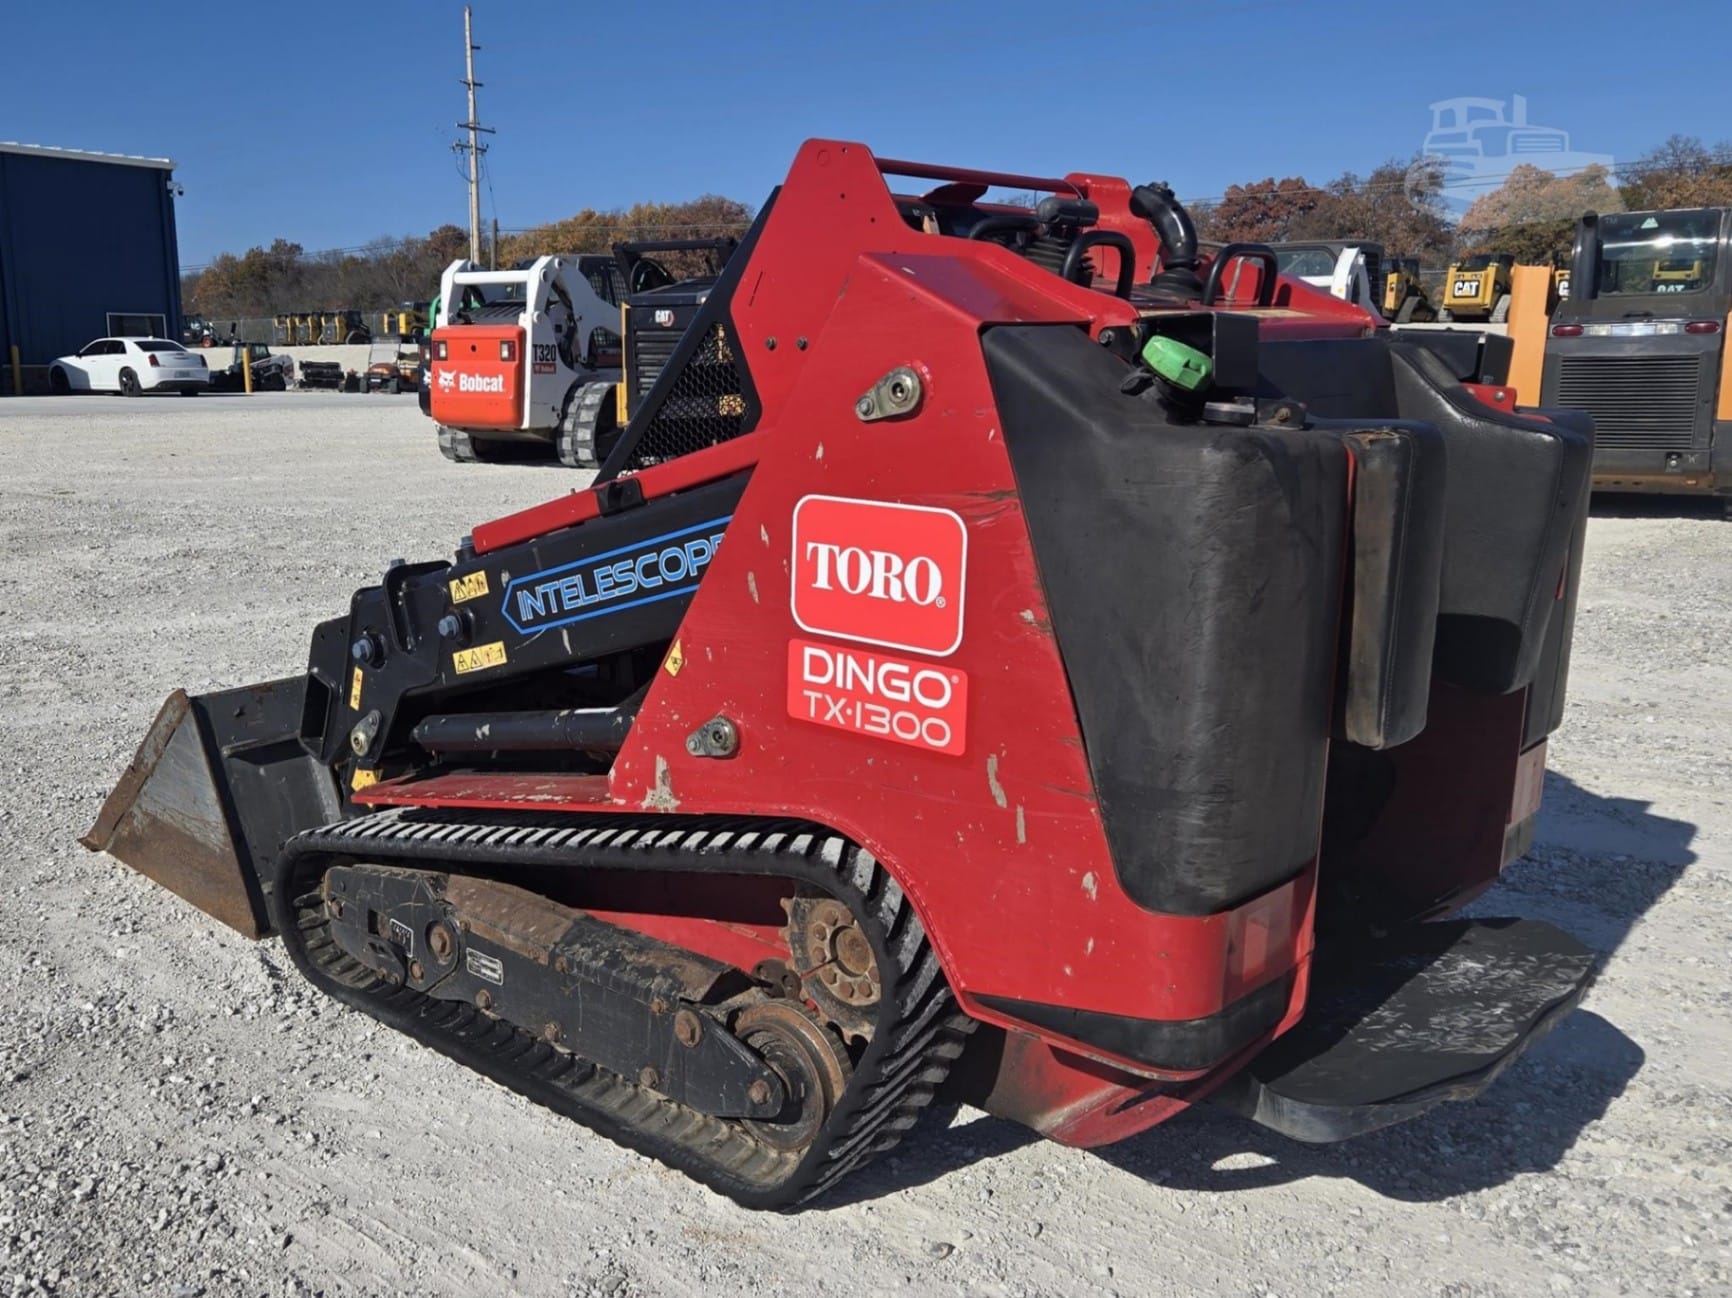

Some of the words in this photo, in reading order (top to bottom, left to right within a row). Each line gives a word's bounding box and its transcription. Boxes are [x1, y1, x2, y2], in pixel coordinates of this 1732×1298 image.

[1454, 281, 1479, 297] CAT
[533, 344, 557, 361] T320
[459, 373, 504, 392] Bobcat
